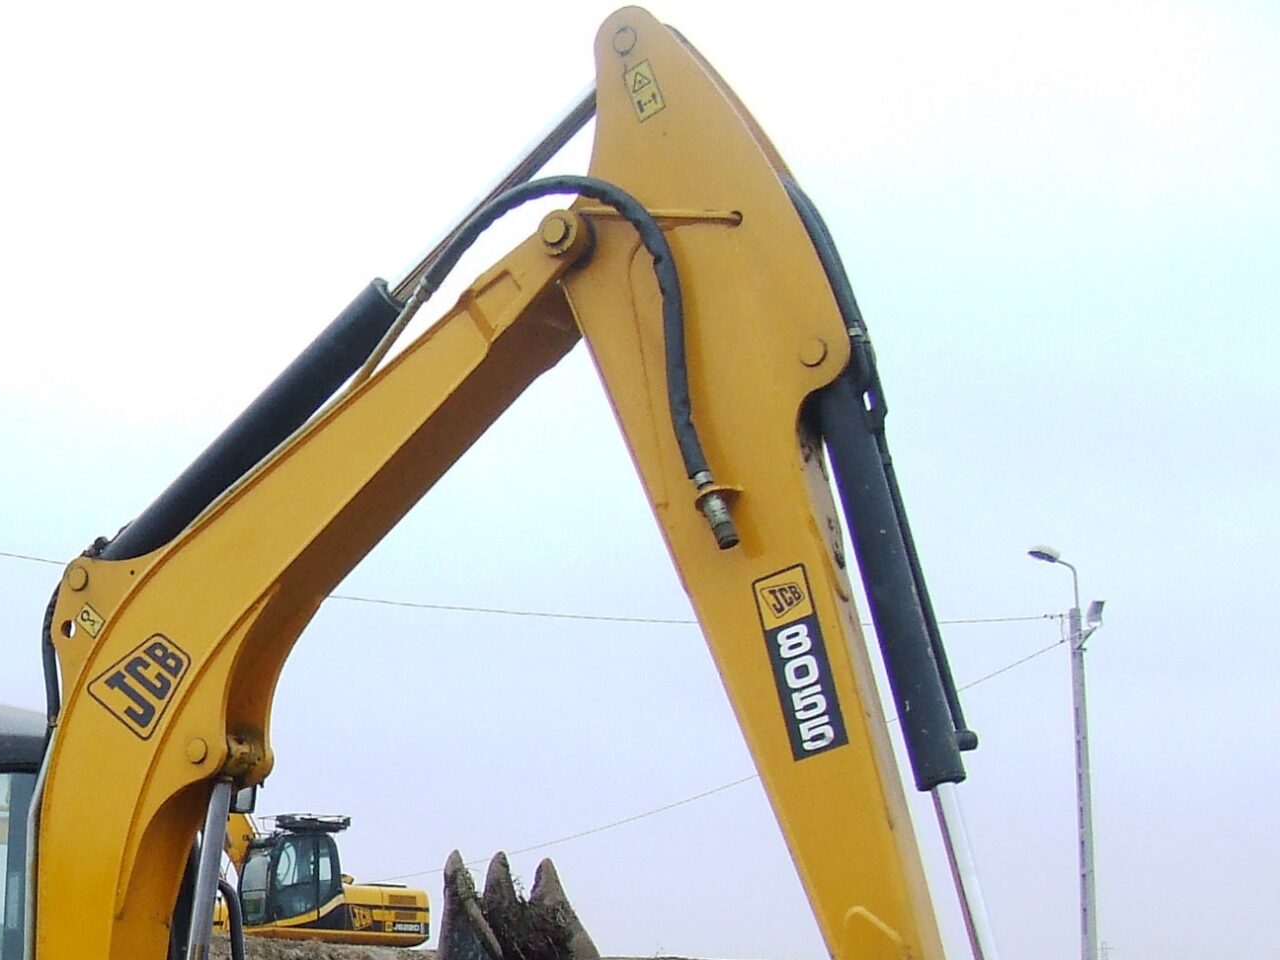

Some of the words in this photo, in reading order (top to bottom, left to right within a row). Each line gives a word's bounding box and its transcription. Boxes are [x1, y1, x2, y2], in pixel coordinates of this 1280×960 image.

[769, 585, 803, 613] JCB
[105, 642, 184, 728] JCB
[777, 624, 835, 751] 8055
